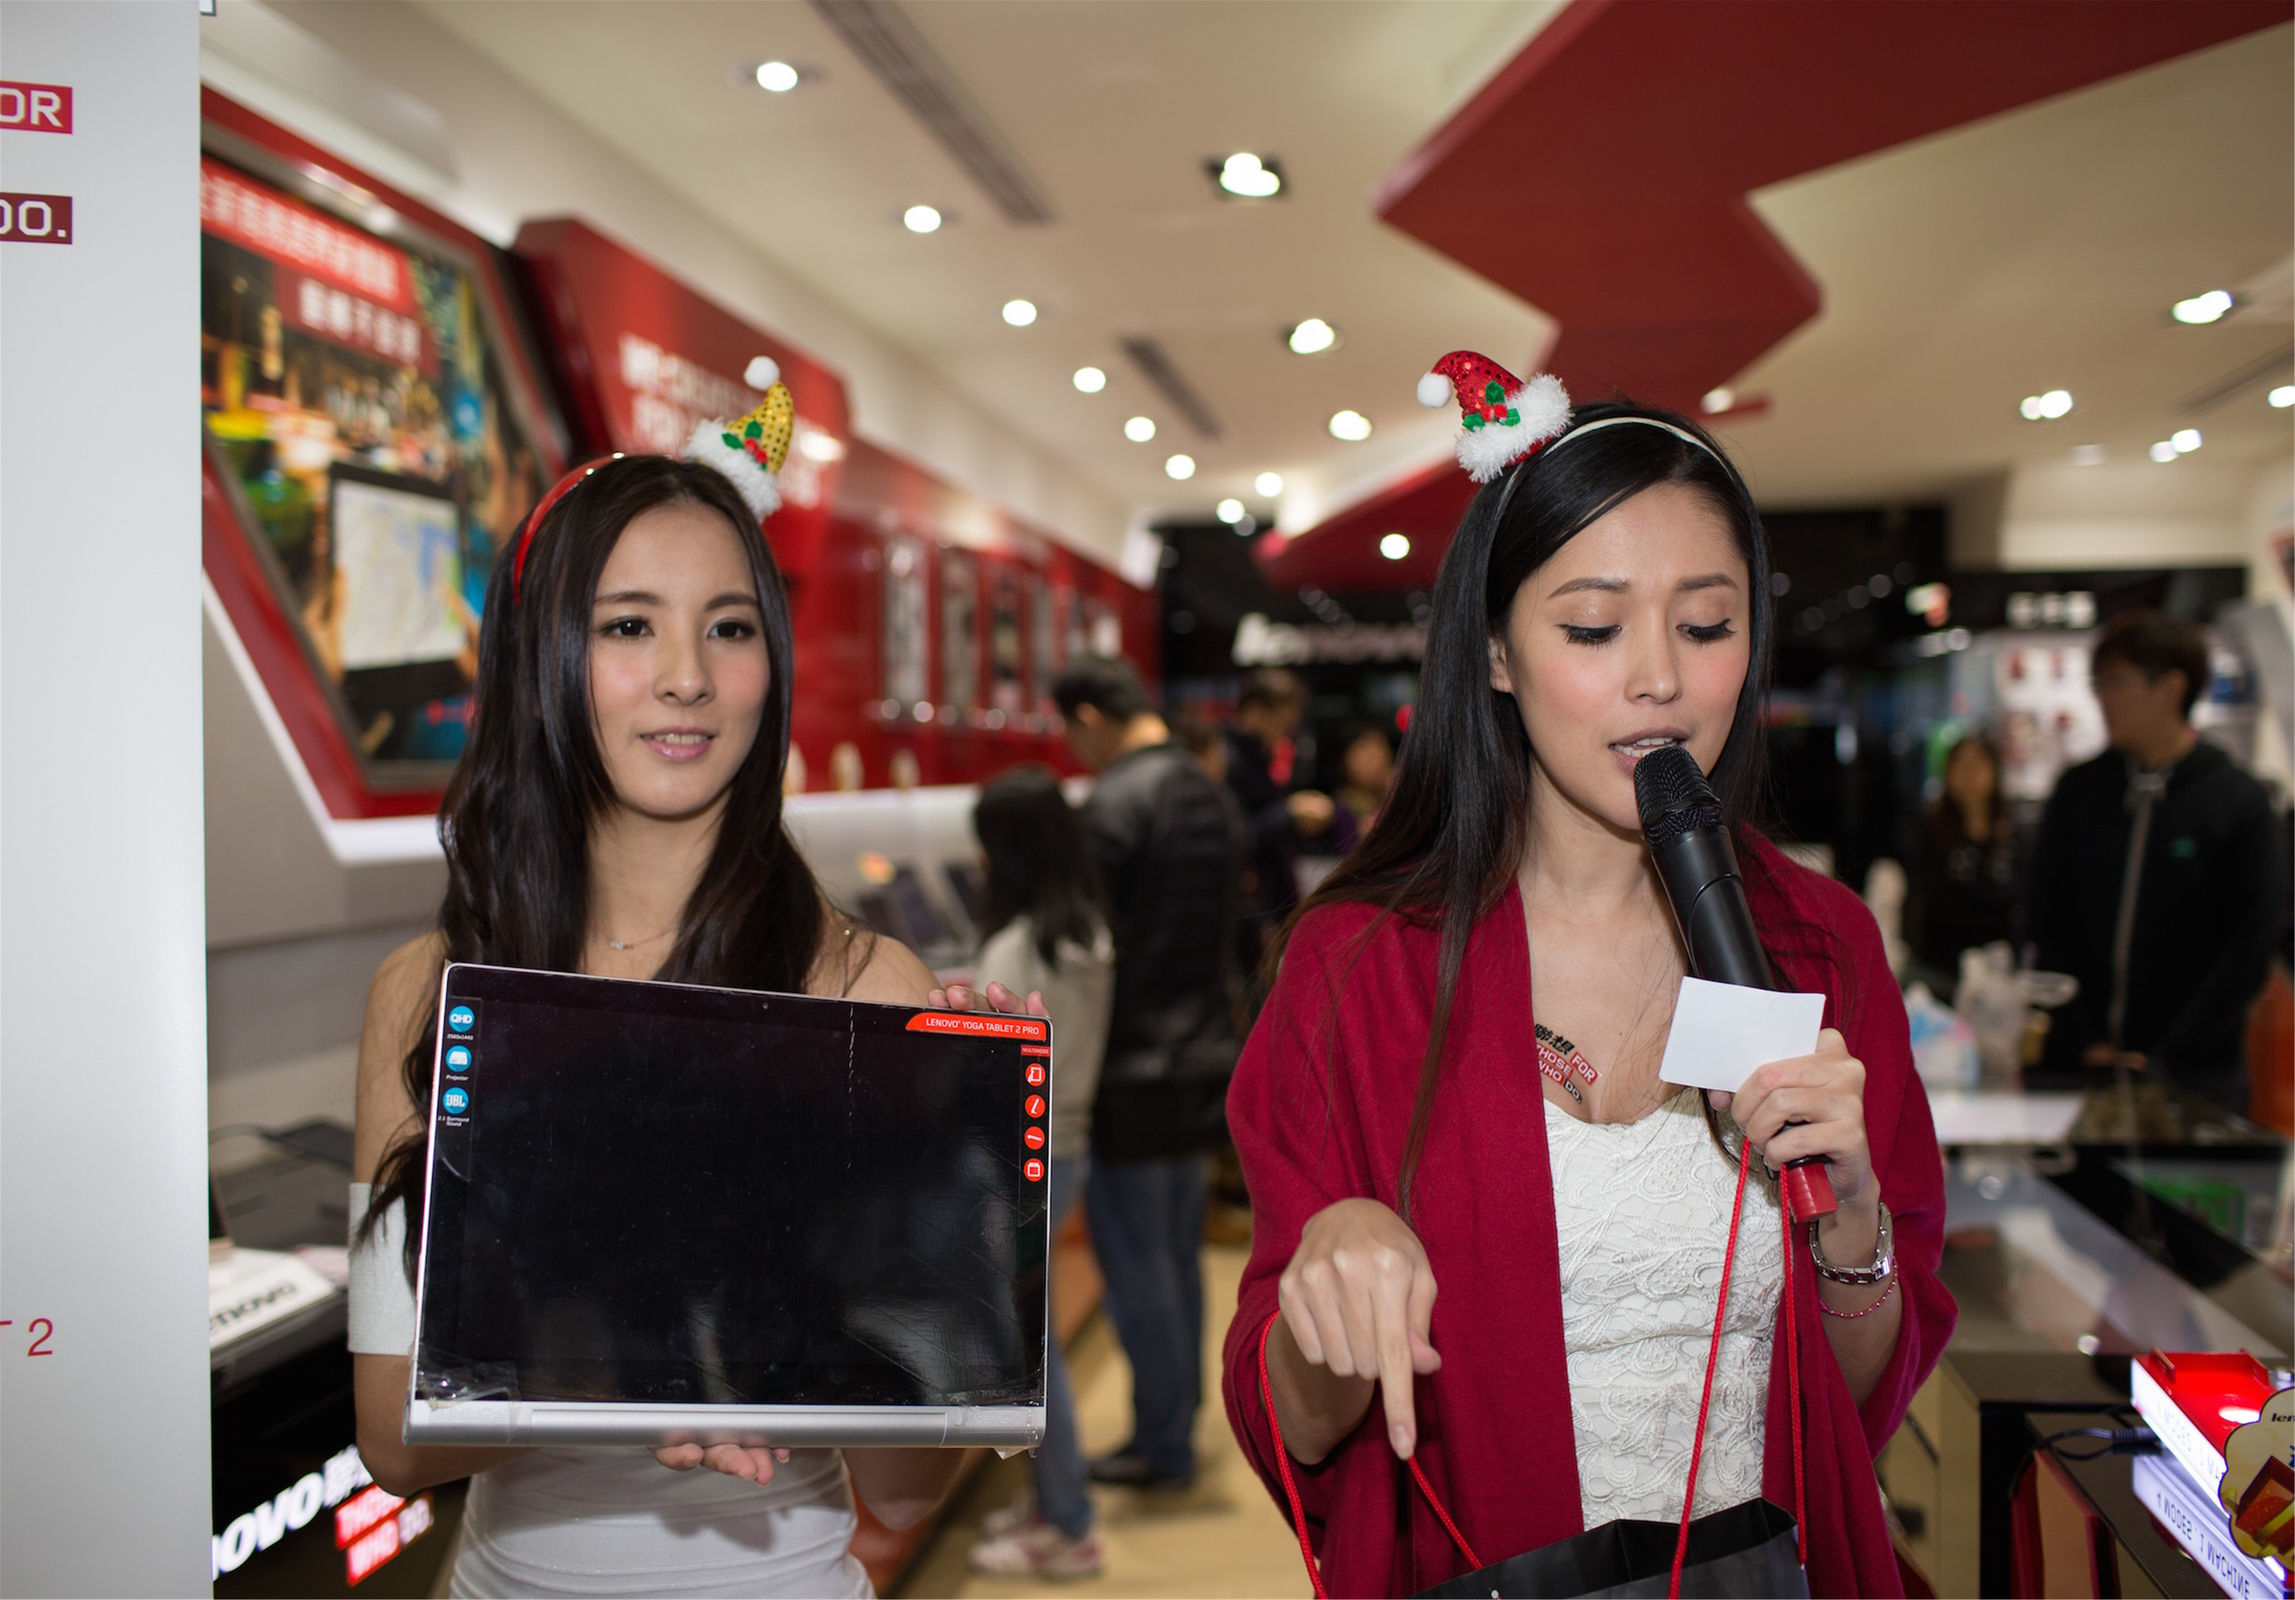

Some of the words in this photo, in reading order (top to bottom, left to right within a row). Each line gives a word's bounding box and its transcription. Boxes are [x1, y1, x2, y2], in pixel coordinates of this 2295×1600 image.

[450, 1013, 473, 1024] QHD
[926, 1018, 959, 1028] LENOVO
[962, 1021, 984, 1031] YOGA
[986, 1024, 1014, 1033] TABLET
[1015, 1026, 1021, 1034] 2
[1022, 1026, 1040, 1035] PRO
[1570, 1054, 1597, 1084] FOR
[446, 1094, 466, 1107] JBL
[27, 1318, 54, 1357] 2
